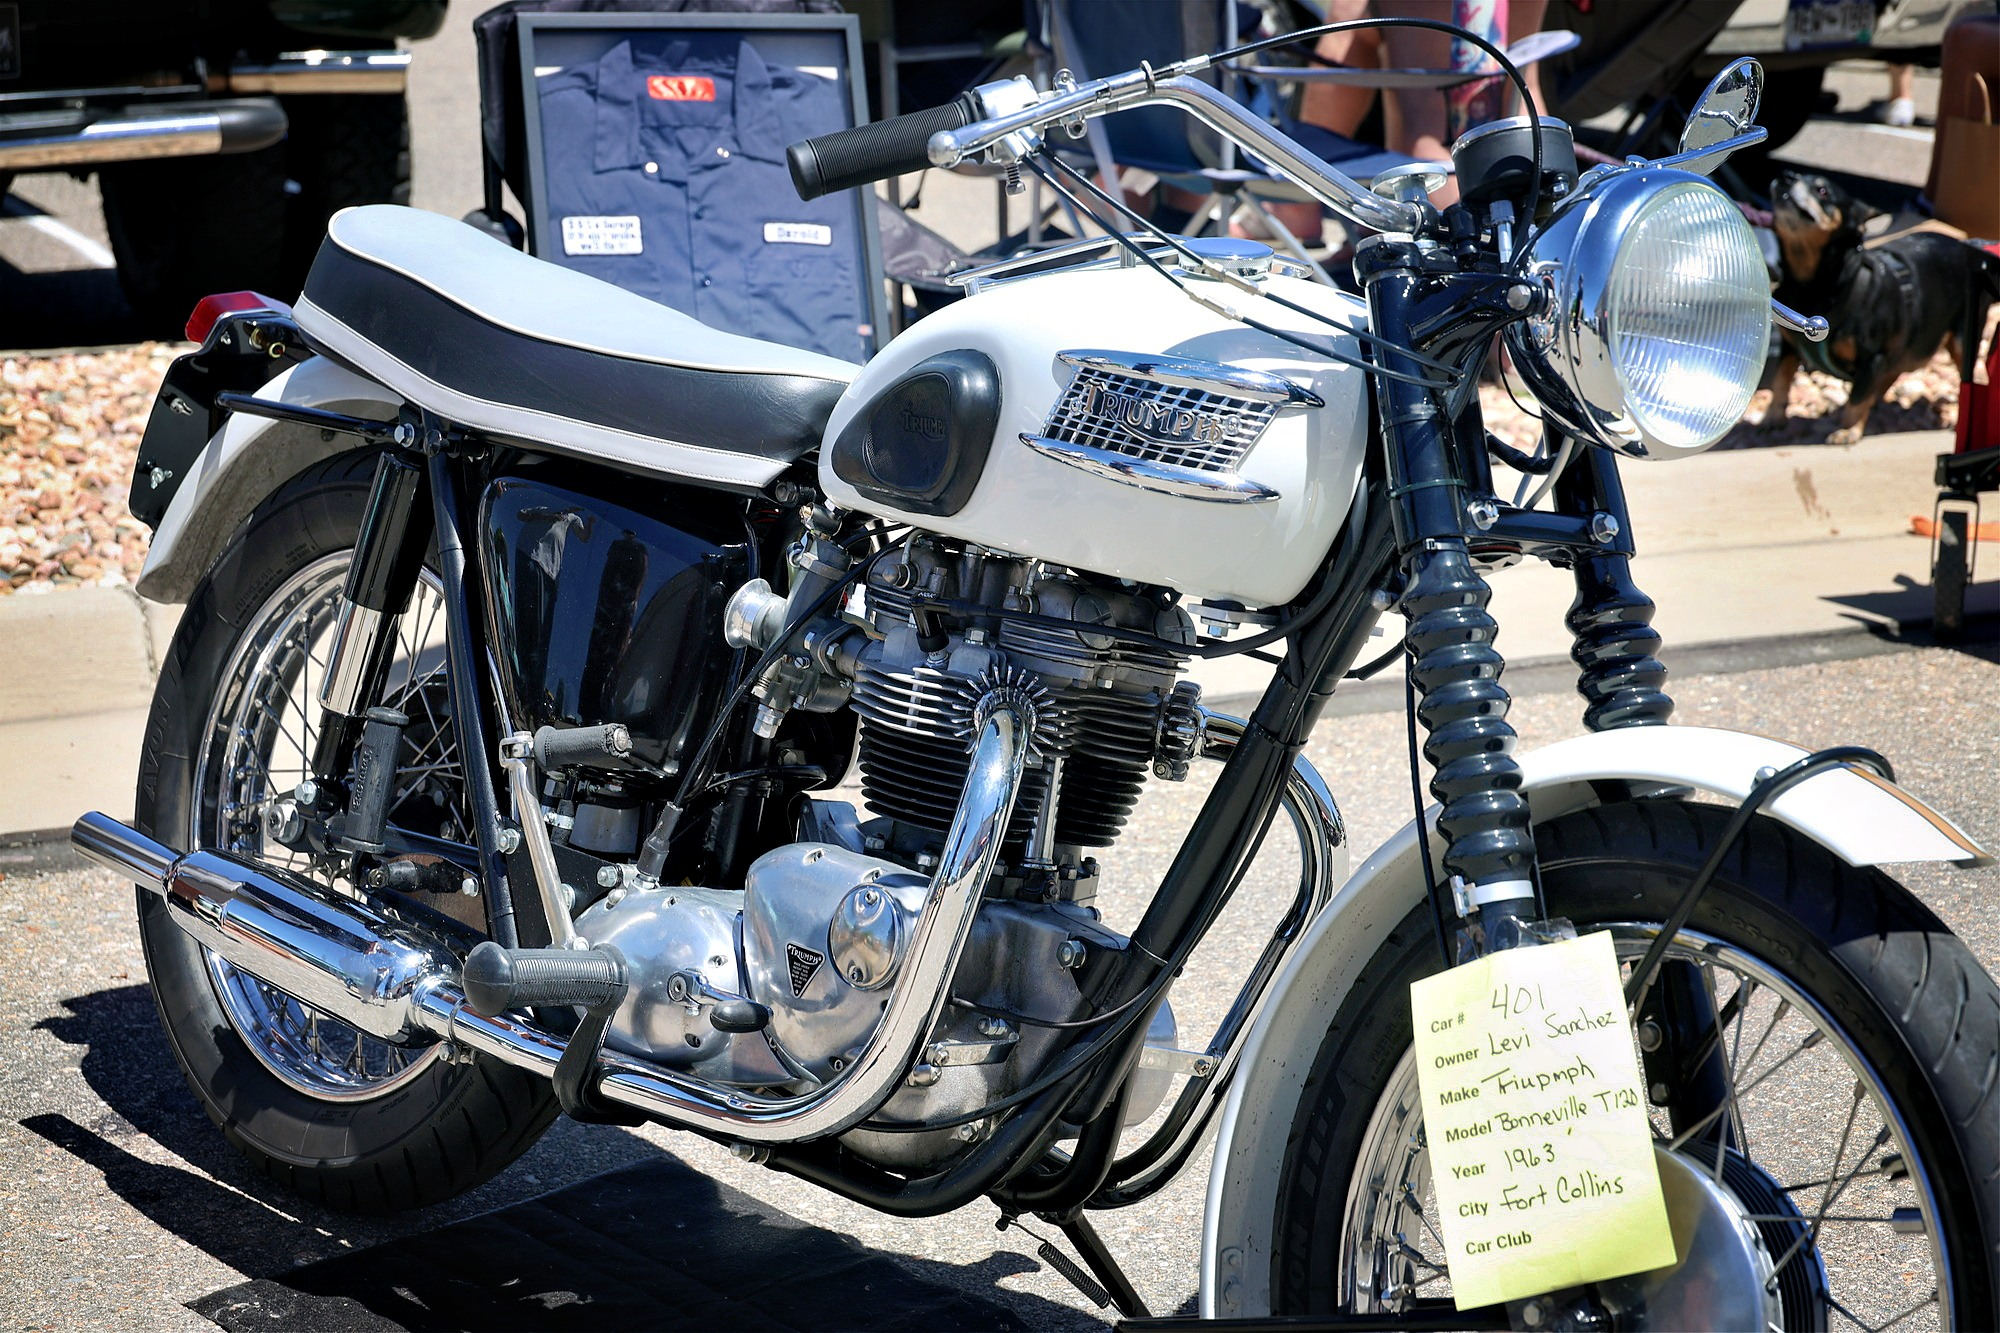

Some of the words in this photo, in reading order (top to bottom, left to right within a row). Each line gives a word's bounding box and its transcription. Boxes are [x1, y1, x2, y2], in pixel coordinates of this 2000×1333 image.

[1083, 378, 1225, 447] TRIUMPH
[143, 694, 171, 803] AVON
[790, 946, 819, 965] TRIUMPH
[1431, 1018, 1453, 1034] Car
[1457, 1011, 1465, 1025] #
[1491, 983, 1545, 1020] 401
[1435, 1048, 1480, 1069] Owner
[1488, 1027, 1531, 1056] Levi
[1544, 1006, 1617, 1039] Sanchez
[1440, 1086, 1480, 1106] Make
[1445, 1120, 1492, 1143] Model
[1494, 1095, 1588, 1132] Bonneville
[1592, 1087, 1639, 1113] T120
[1452, 1162, 1486, 1180] Year
[1503, 1143, 1556, 1173] 1963
[1458, 1201, 1489, 1218] City
[1499, 1183, 1548, 1211] Fort
[1556, 1169, 1625, 1204] Collins
[1465, 1239, 1492, 1256] Car
[1496, 1230, 1533, 1249] Club
